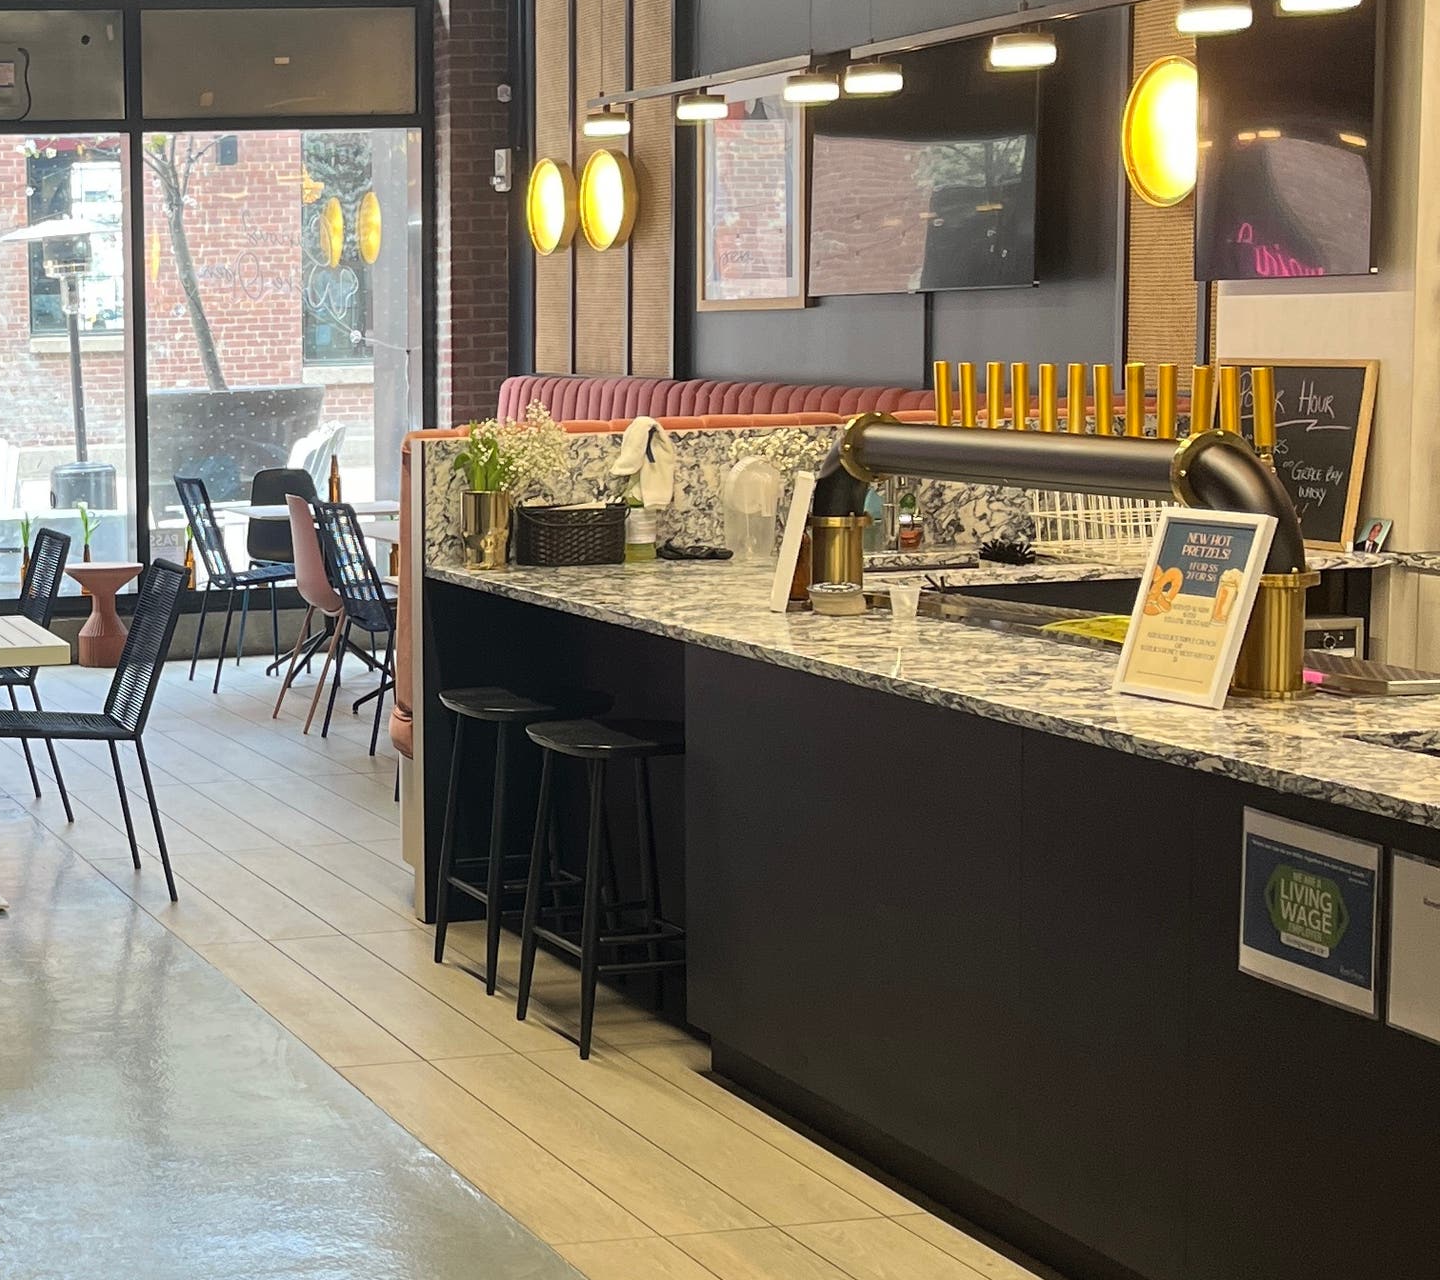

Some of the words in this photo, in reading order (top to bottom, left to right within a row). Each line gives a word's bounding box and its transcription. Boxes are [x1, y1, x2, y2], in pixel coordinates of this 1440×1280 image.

[1187, 532, 1211, 545] NEW
[1210, 534, 1233, 547] HOT
[1279, 877, 1332, 913] LIVING
[1279, 898, 1332, 935] WAGE
